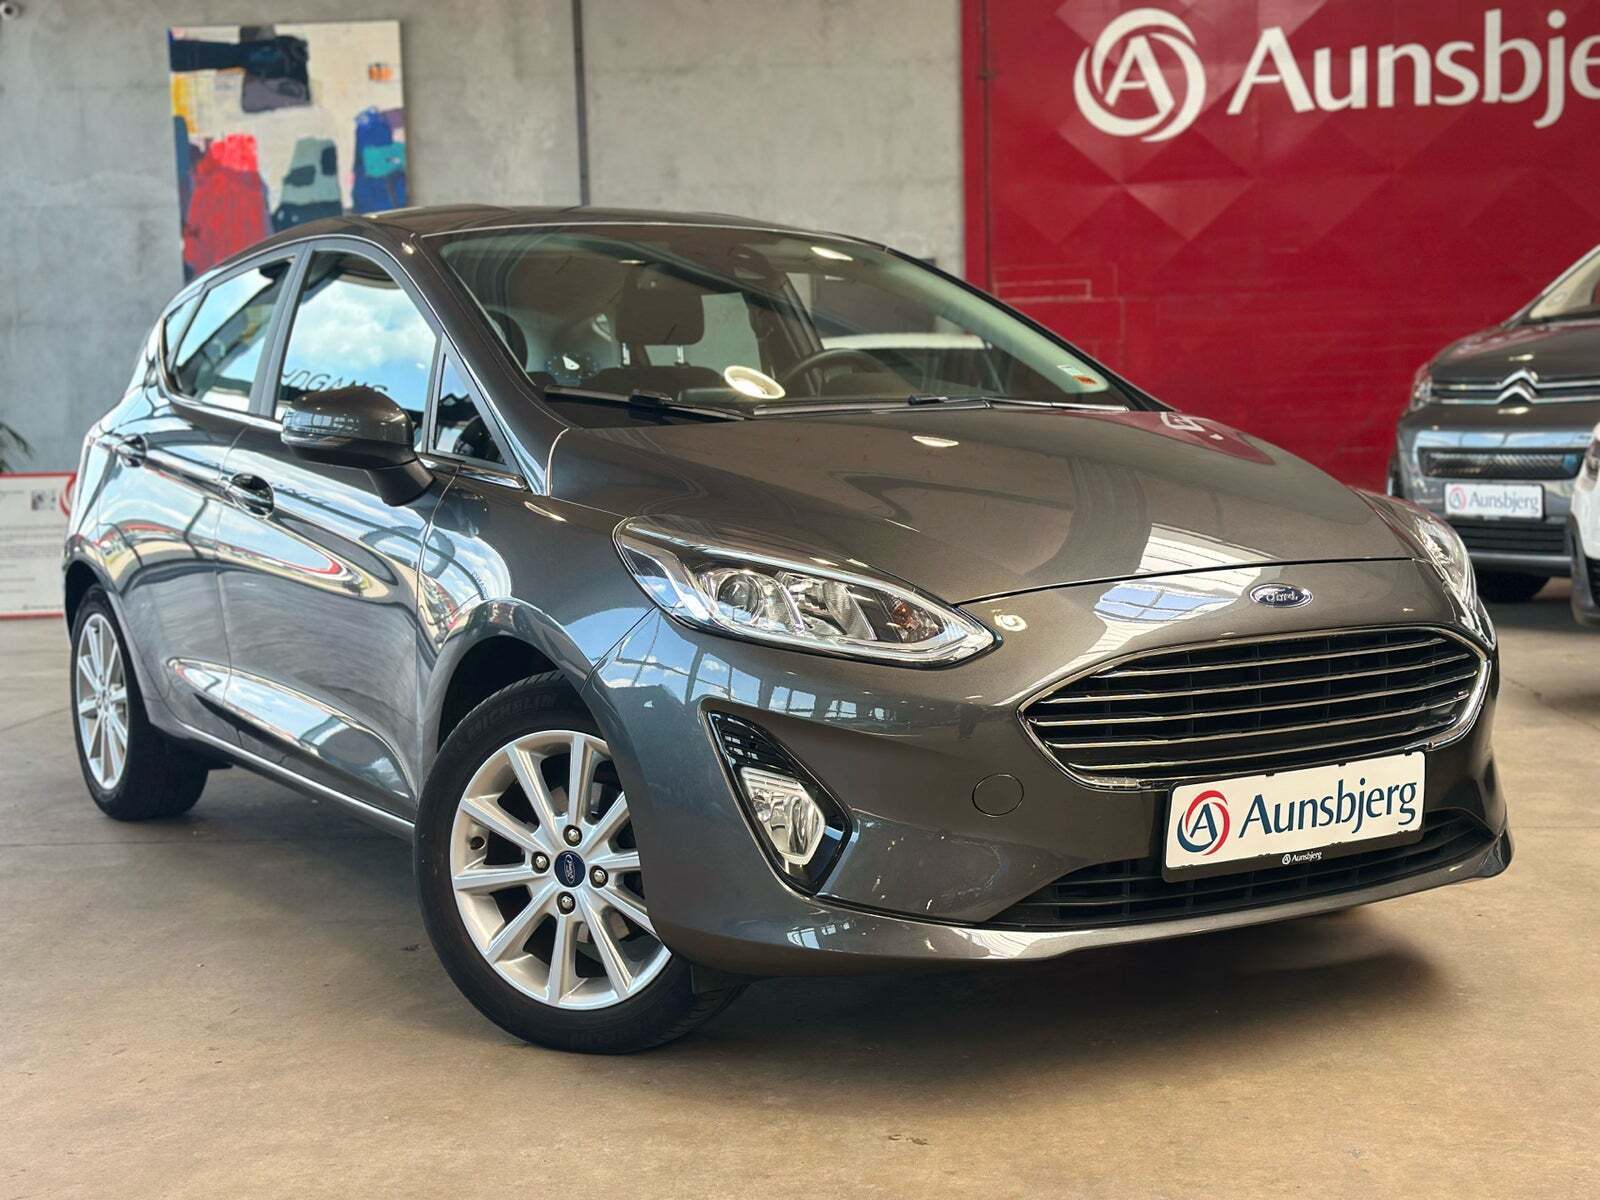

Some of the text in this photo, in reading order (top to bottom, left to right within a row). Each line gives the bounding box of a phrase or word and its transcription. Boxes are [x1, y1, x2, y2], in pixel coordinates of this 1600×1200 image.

[1469, 491, 1539, 514] Aunsbjerg
[1238, 777, 1417, 838] Aunsbjerg
[1291, 851, 1322, 862] Aunsbjerg
